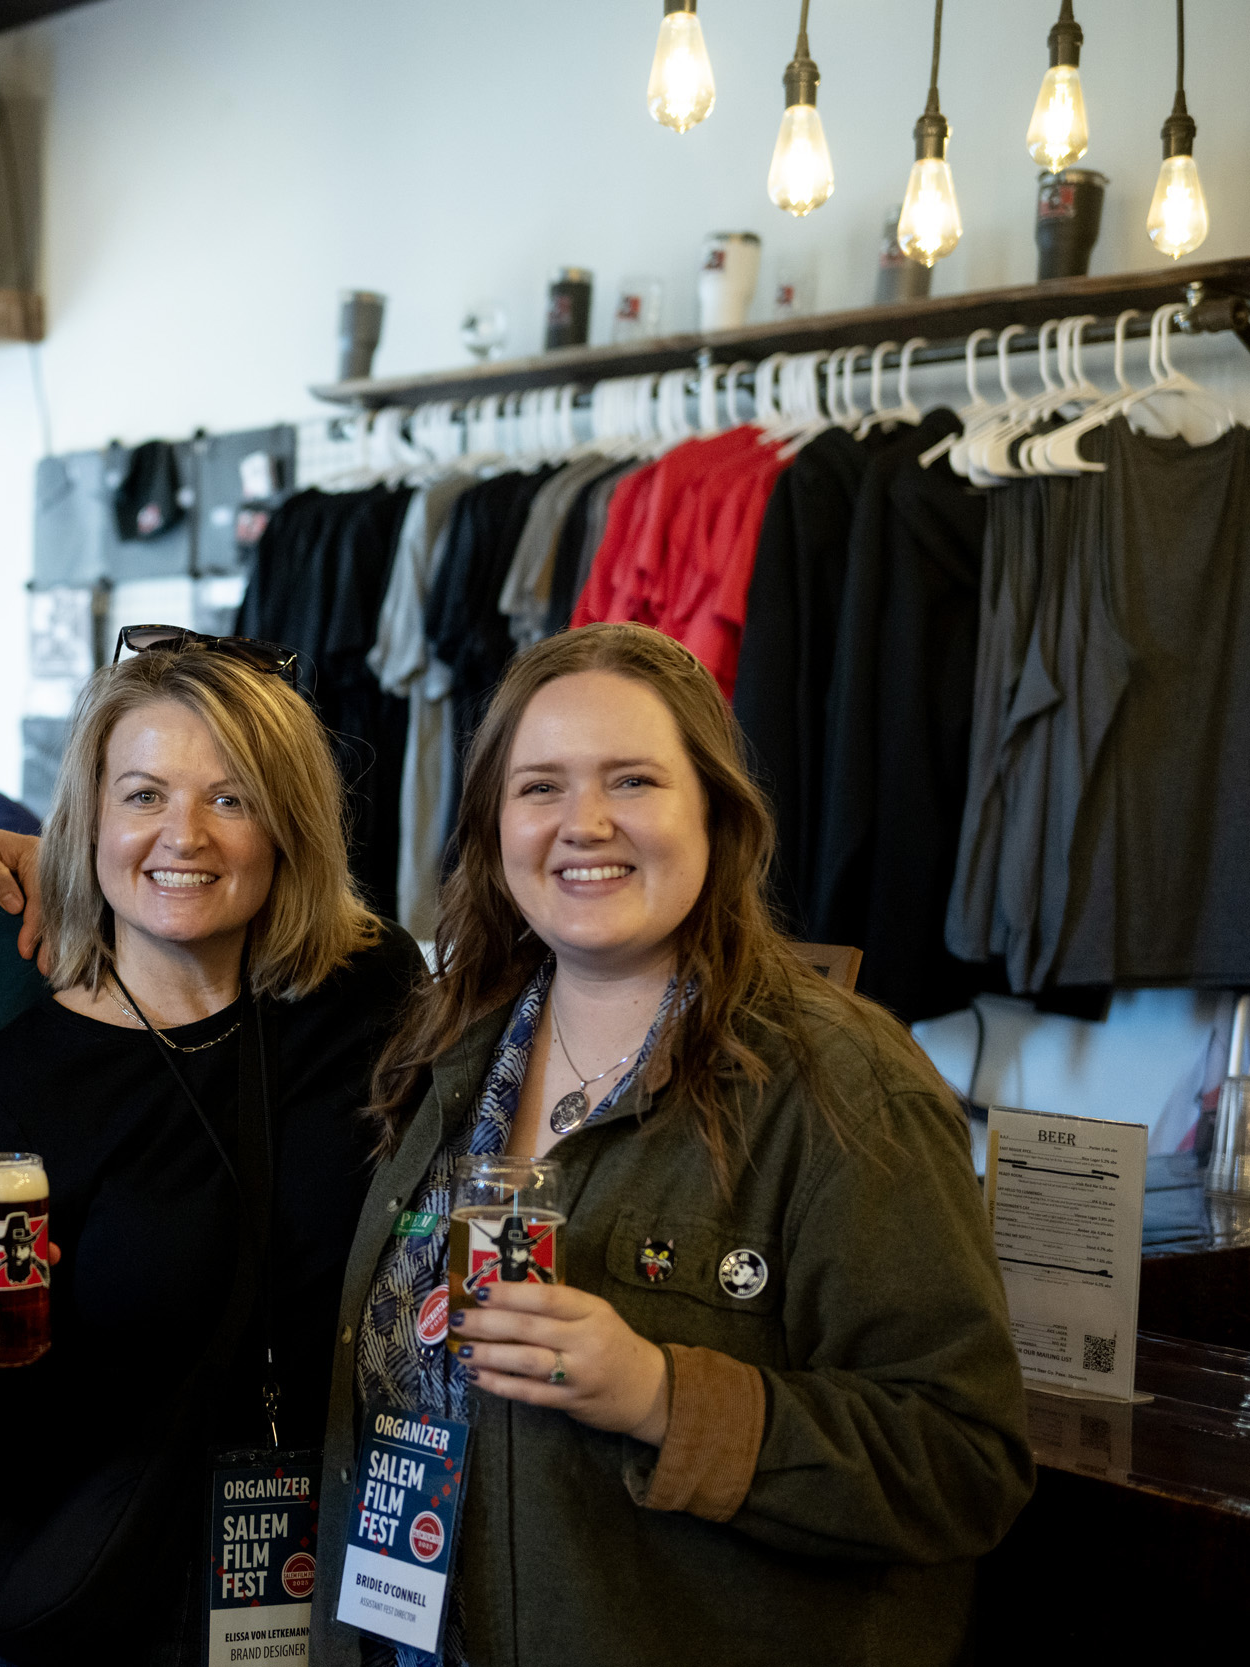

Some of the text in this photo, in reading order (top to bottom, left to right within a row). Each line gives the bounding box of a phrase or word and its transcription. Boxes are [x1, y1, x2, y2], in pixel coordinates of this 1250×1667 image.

[1038, 1129, 1076, 1146] BEER
[1036, 1350, 1059, 1360] MAILING
[375, 1413, 450, 1452] ORGANIZER
[367, 1450, 425, 1491] SALEM
[223, 1477, 310, 1500] ORGANIZER
[363, 1479, 405, 1517] FILM
[223, 1512, 288, 1542] SALEM
[358, 1509, 400, 1547] FEST
[223, 1542, 269, 1570] FILM
[222, 1570, 268, 1599] FEST
[355, 1573, 427, 1608] BRIDIE O'CONNELL
[359, 1596, 417, 1623] ASSISTANT FEST DIRECTOR
[225, 1630, 250, 1643] ELISSA
[251, 1629, 266, 1641] VON
[230, 1643, 306, 1662] BRAND DESIGNER
